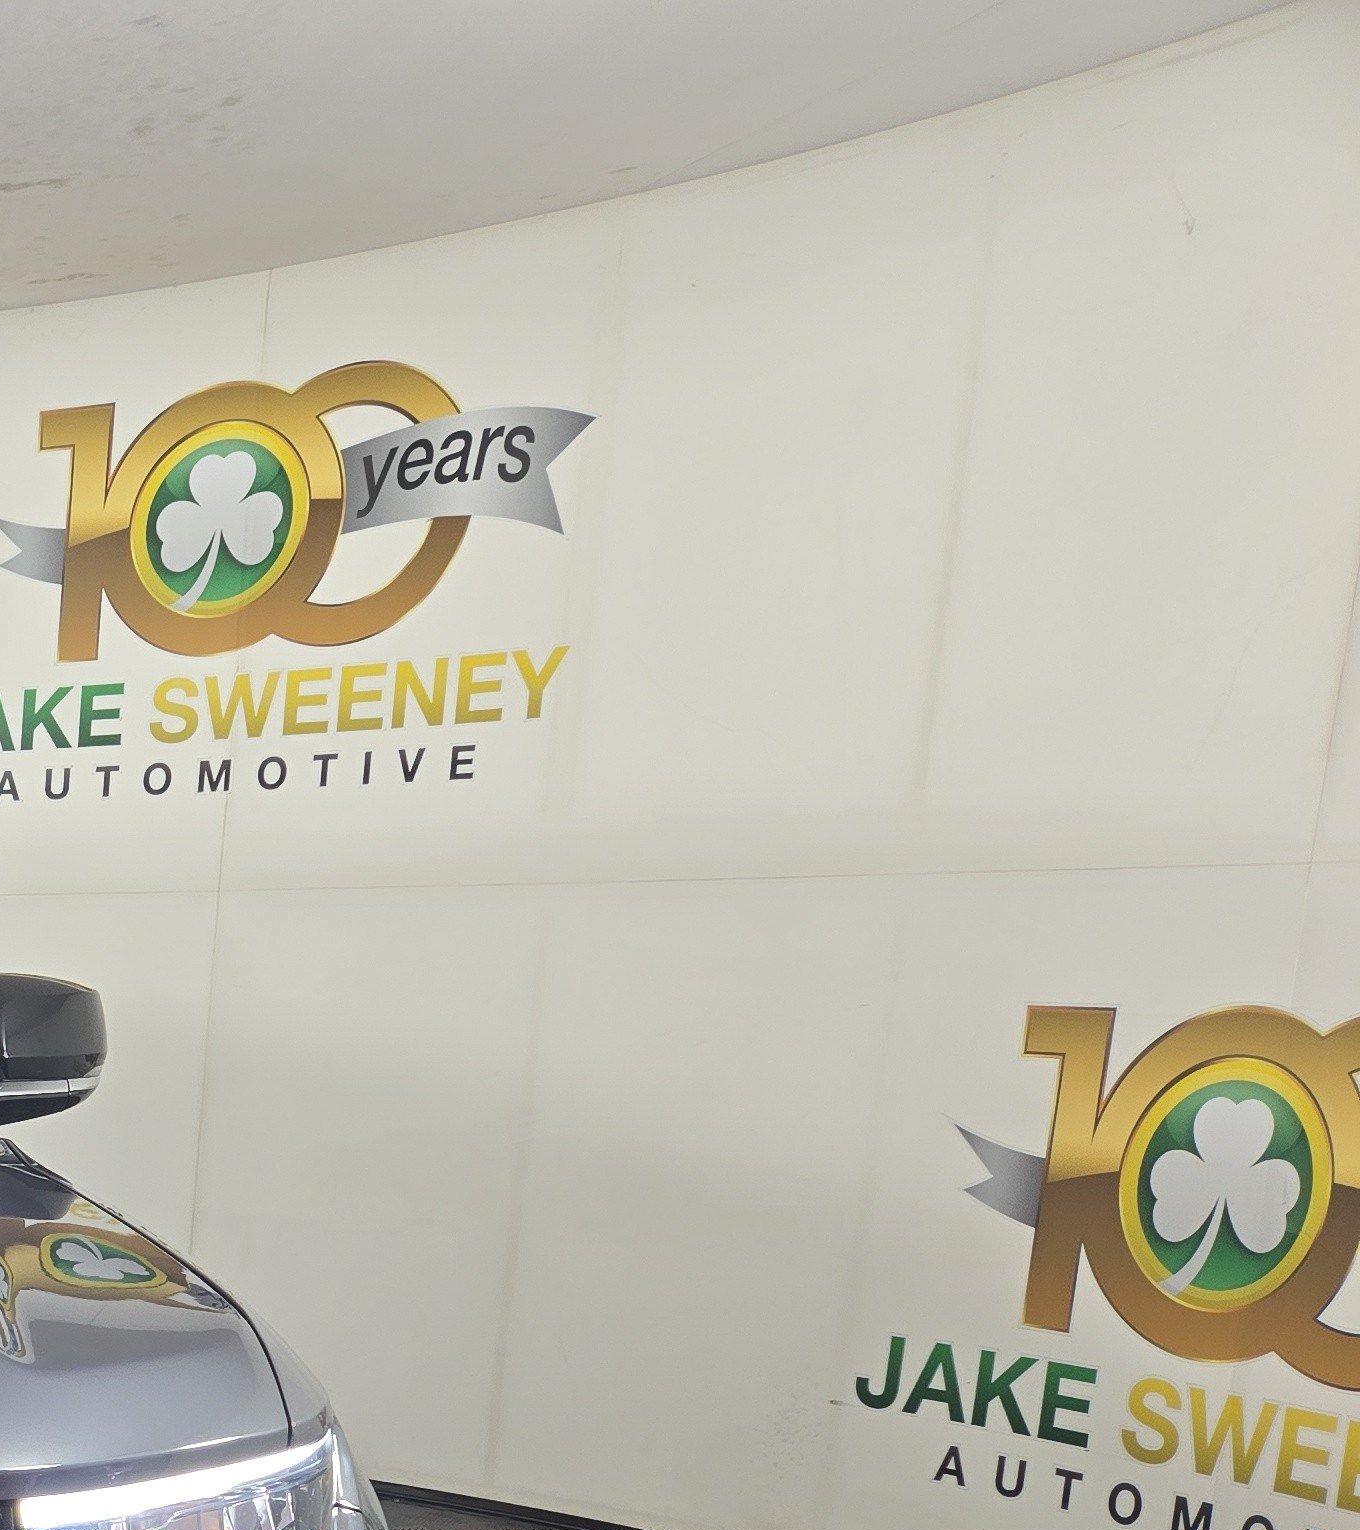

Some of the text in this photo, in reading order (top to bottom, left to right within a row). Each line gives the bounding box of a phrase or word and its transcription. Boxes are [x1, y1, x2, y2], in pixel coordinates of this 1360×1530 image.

[356, 421, 537, 519] years
[149, 645, 571, 745] SWEENEY
[855, 1335, 1098, 1449] JAKE
